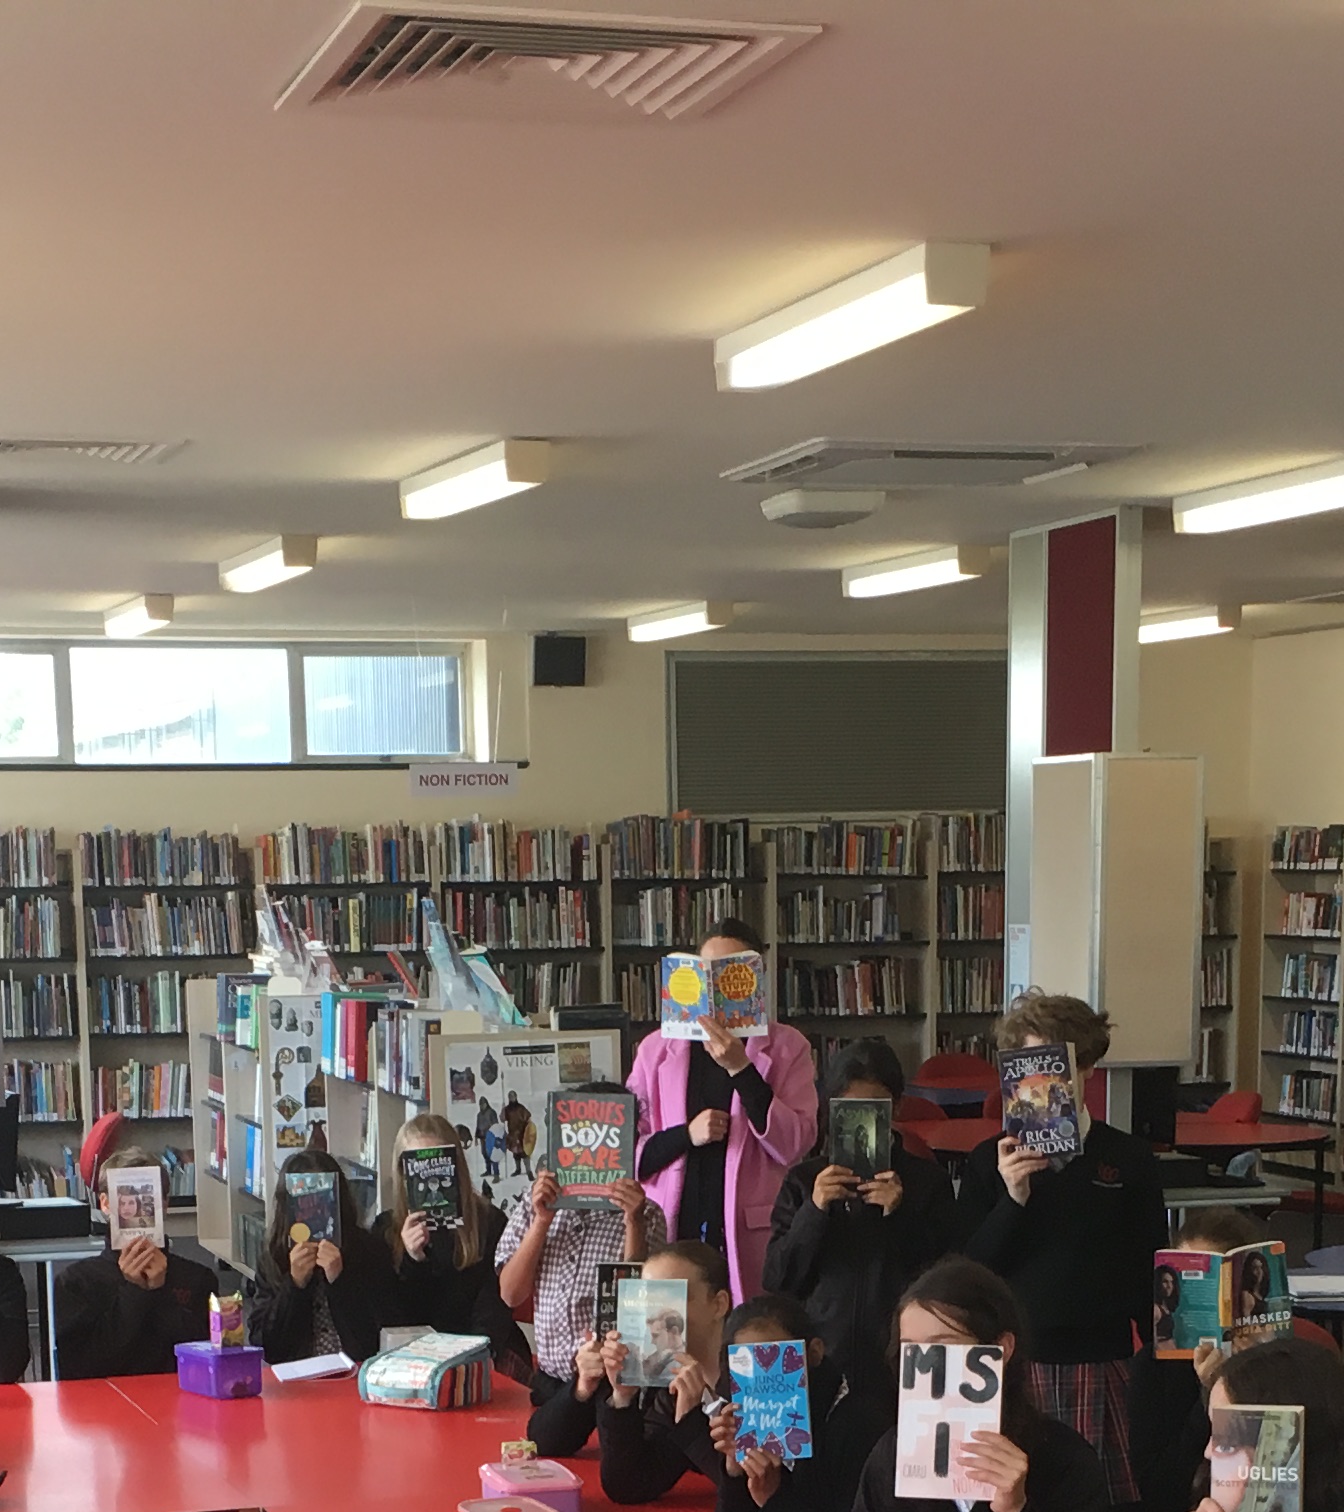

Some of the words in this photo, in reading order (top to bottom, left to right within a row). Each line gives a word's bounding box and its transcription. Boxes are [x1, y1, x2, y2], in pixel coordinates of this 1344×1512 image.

[419, 774, 450, 787] NON
[454, 773, 509, 786] FICTION
[505, 1055, 554, 1068] VIKING
[1013, 1055, 1052, 1067] TRIALS
[1004, 1062, 1065, 1081] APOLLO
[556, 1100, 625, 1125] STORIES
[561, 1123, 620, 1152] BOYS
[1025, 1127, 1061, 1143] RICK
[557, 1146, 623, 1169] DARE
[407, 1159, 430, 1176] LONG
[430, 1157, 452, 1167] CLASS
[556, 1168, 627, 1187] DIFFERENT
[1235, 1310, 1291, 1327] NMASKED
[744, 1383, 795, 1396] DAWSON
[743, 1395, 799, 1418] Margot
[1237, 1464, 1299, 1481] UGLIES
[1215, 1479, 1241, 1488] SCOTT
